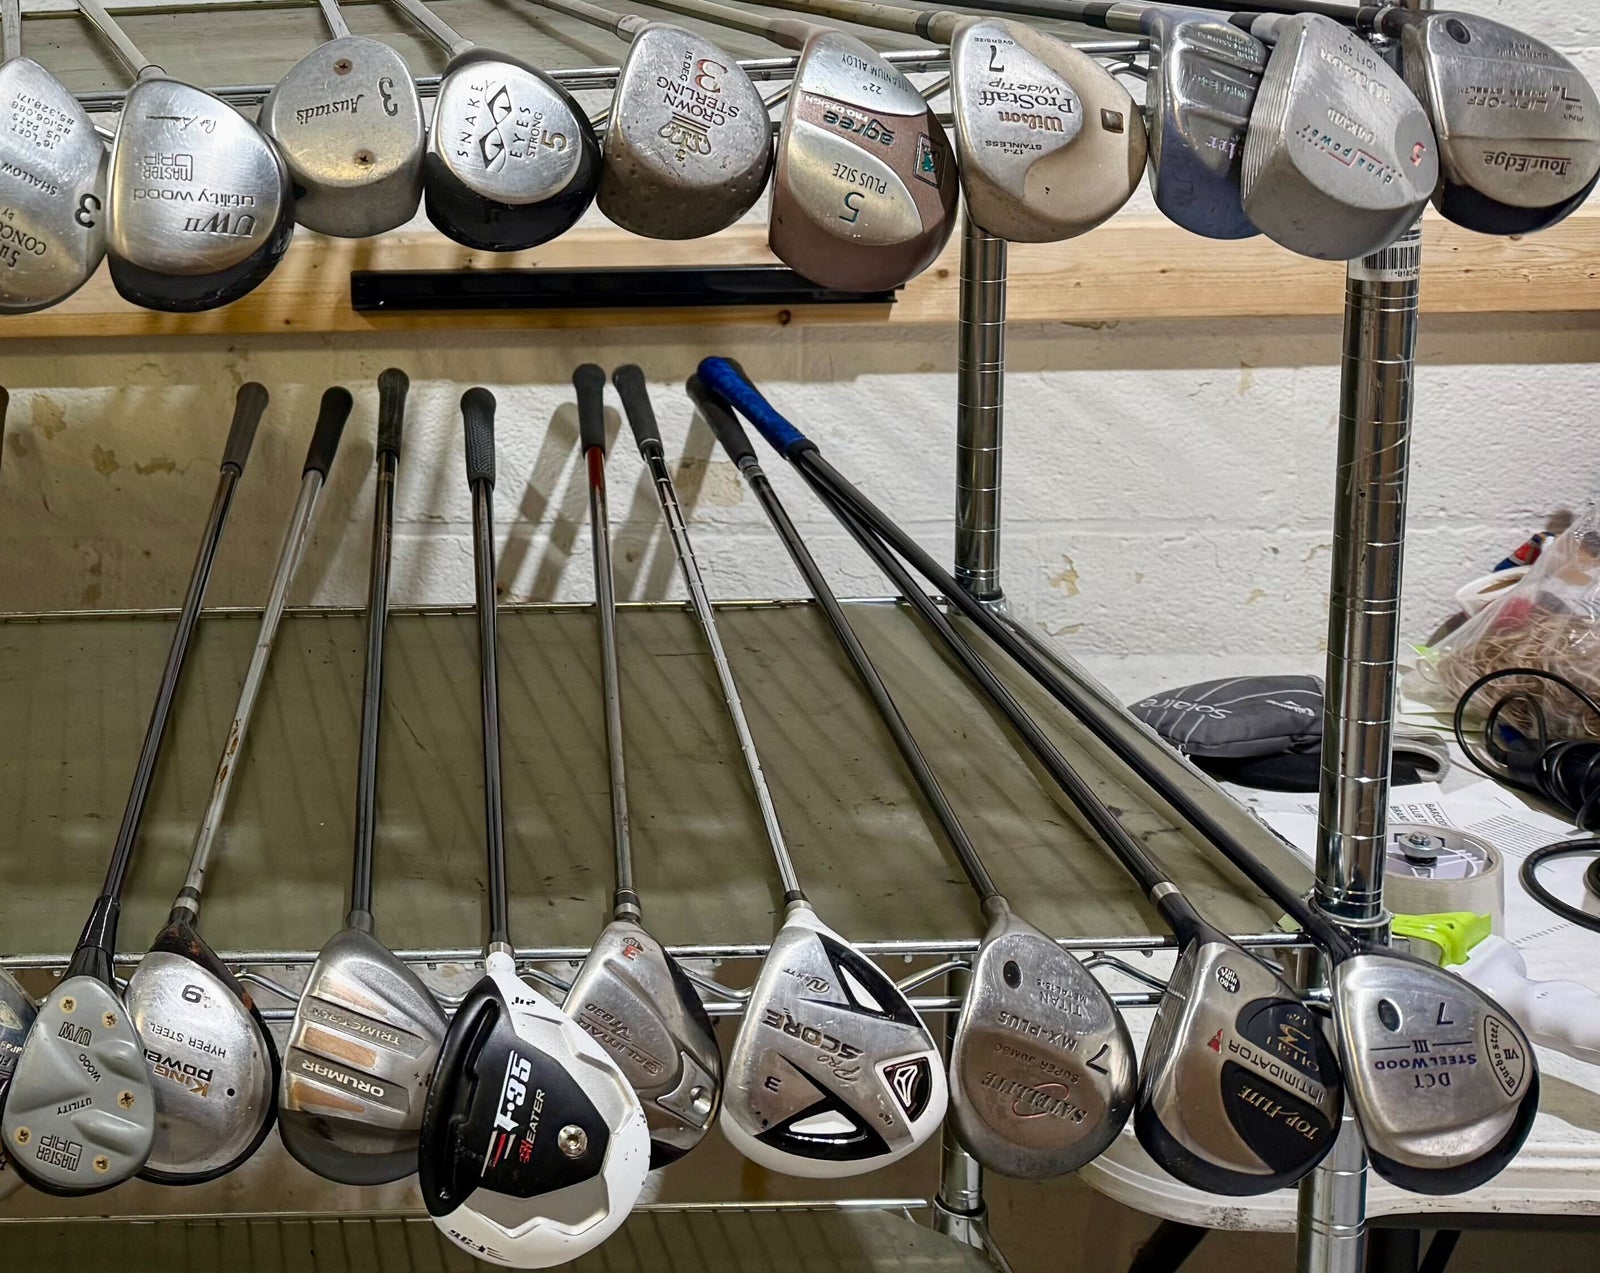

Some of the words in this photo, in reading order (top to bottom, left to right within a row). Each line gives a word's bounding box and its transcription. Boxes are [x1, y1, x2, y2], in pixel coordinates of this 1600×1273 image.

[841, 53, 869, 71] ALLOY
[988, 44, 1006, 73] 7
[696, 58, 728, 94] 3
[378, 77, 399, 116] 3
[656, 76, 741, 119] STERLING
[662, 93, 726, 126] CROWN
[977, 90, 1074, 114] ProStaff
[456, 83, 486, 158] SNAKE
[510, 105, 532, 159] EYES
[526, 110, 544, 158] STRONG
[823, 111, 895, 146] agree
[999, 111, 1065, 133] Wilson
[542, 129, 568, 152] 5
[7, 163, 58, 197] SHALLOW
[832, 162, 861, 184] SIZE
[861, 172, 887, 195] PLUS
[133, 187, 194, 204] wood
[199, 189, 255, 208] utility
[839, 191, 865, 224] 5
[75, 193, 102, 229] 3
[1039, 991, 1084, 1018] TITAN
[1436, 1002, 1455, 1026] 7
[149, 1023, 184, 1044] STEEL
[763, 1008, 864, 1060] SCORE
[998, 1011, 1080, 1052] MX-PLUS
[189, 1038, 227, 1058] HYPER
[1086, 1044, 1110, 1076] 7
[76, 1054, 102, 1083] WOOD
[153, 1066, 208, 1099] KING
[302, 1061, 385, 1098] ORLIMAR
[1038, 1062, 1081, 1083] SUPER
[1414, 1073, 1451, 1089] DCT
[57, 1097, 93, 1115] UTILITY
[982, 1070, 1089, 1125] SATELLITE
